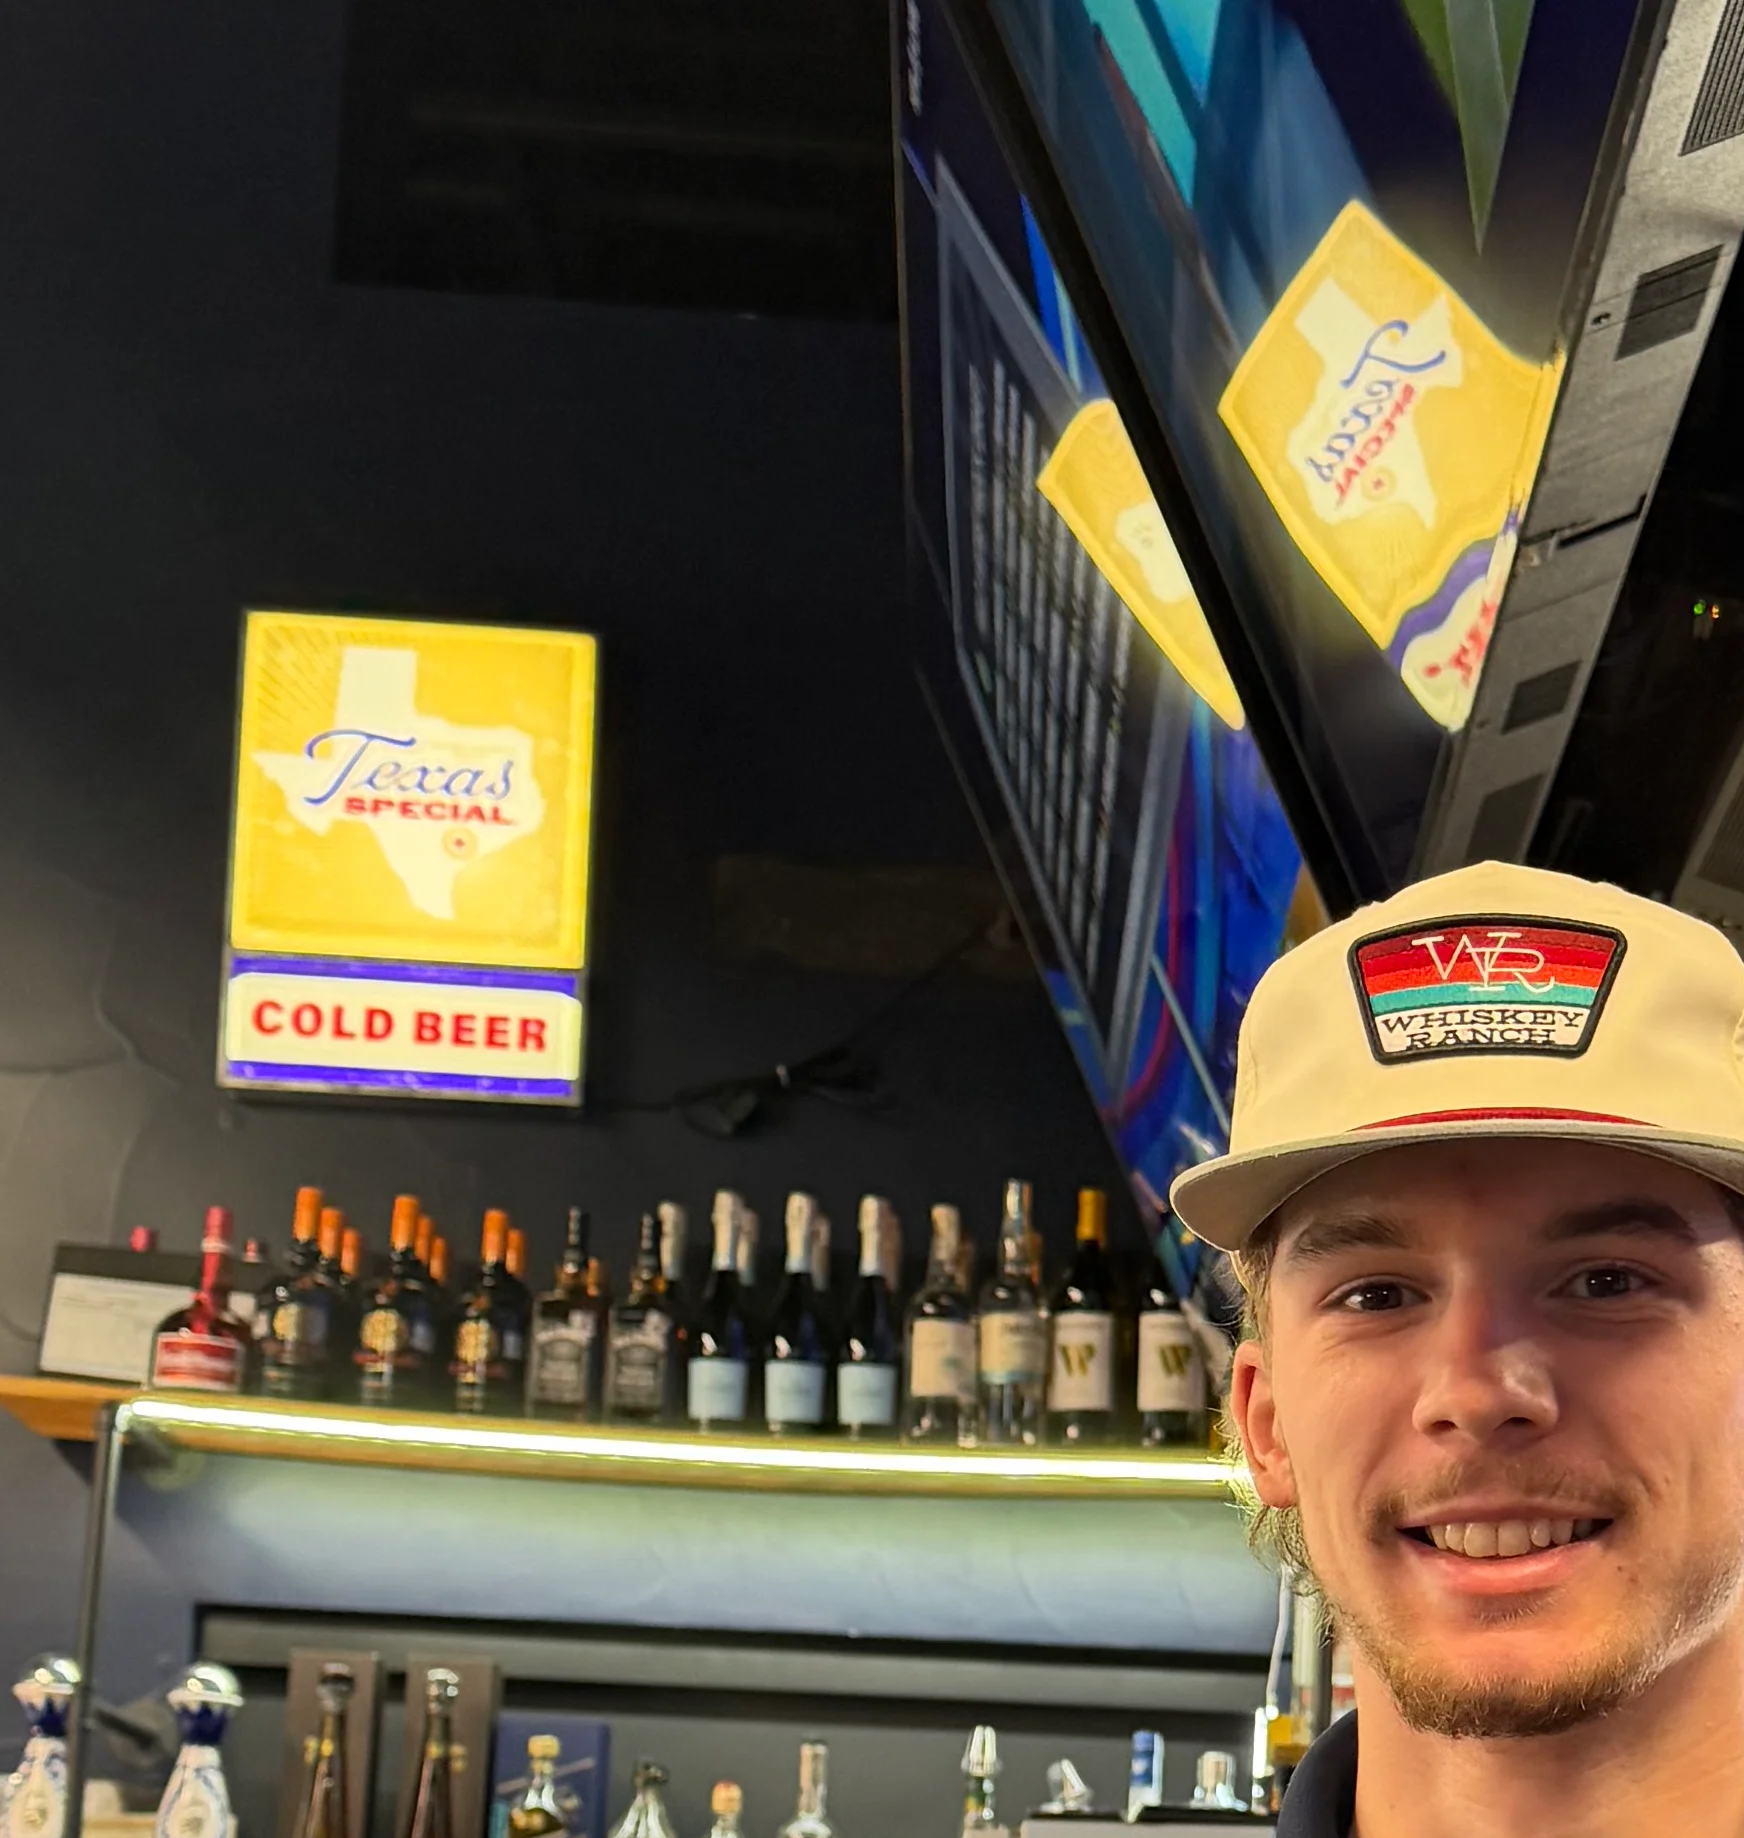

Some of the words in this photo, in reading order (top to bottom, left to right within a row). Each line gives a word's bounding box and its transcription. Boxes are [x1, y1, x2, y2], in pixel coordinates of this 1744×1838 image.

[304, 729, 513, 805] Texas
[343, 797, 518, 825] SPECIAL
[252, 1000, 394, 1041] COLD
[413, 1010, 549, 1053] BEER
[1381, 1009, 1585, 1034] WHISKEY
[1406, 1027, 1557, 1050] RANCH
